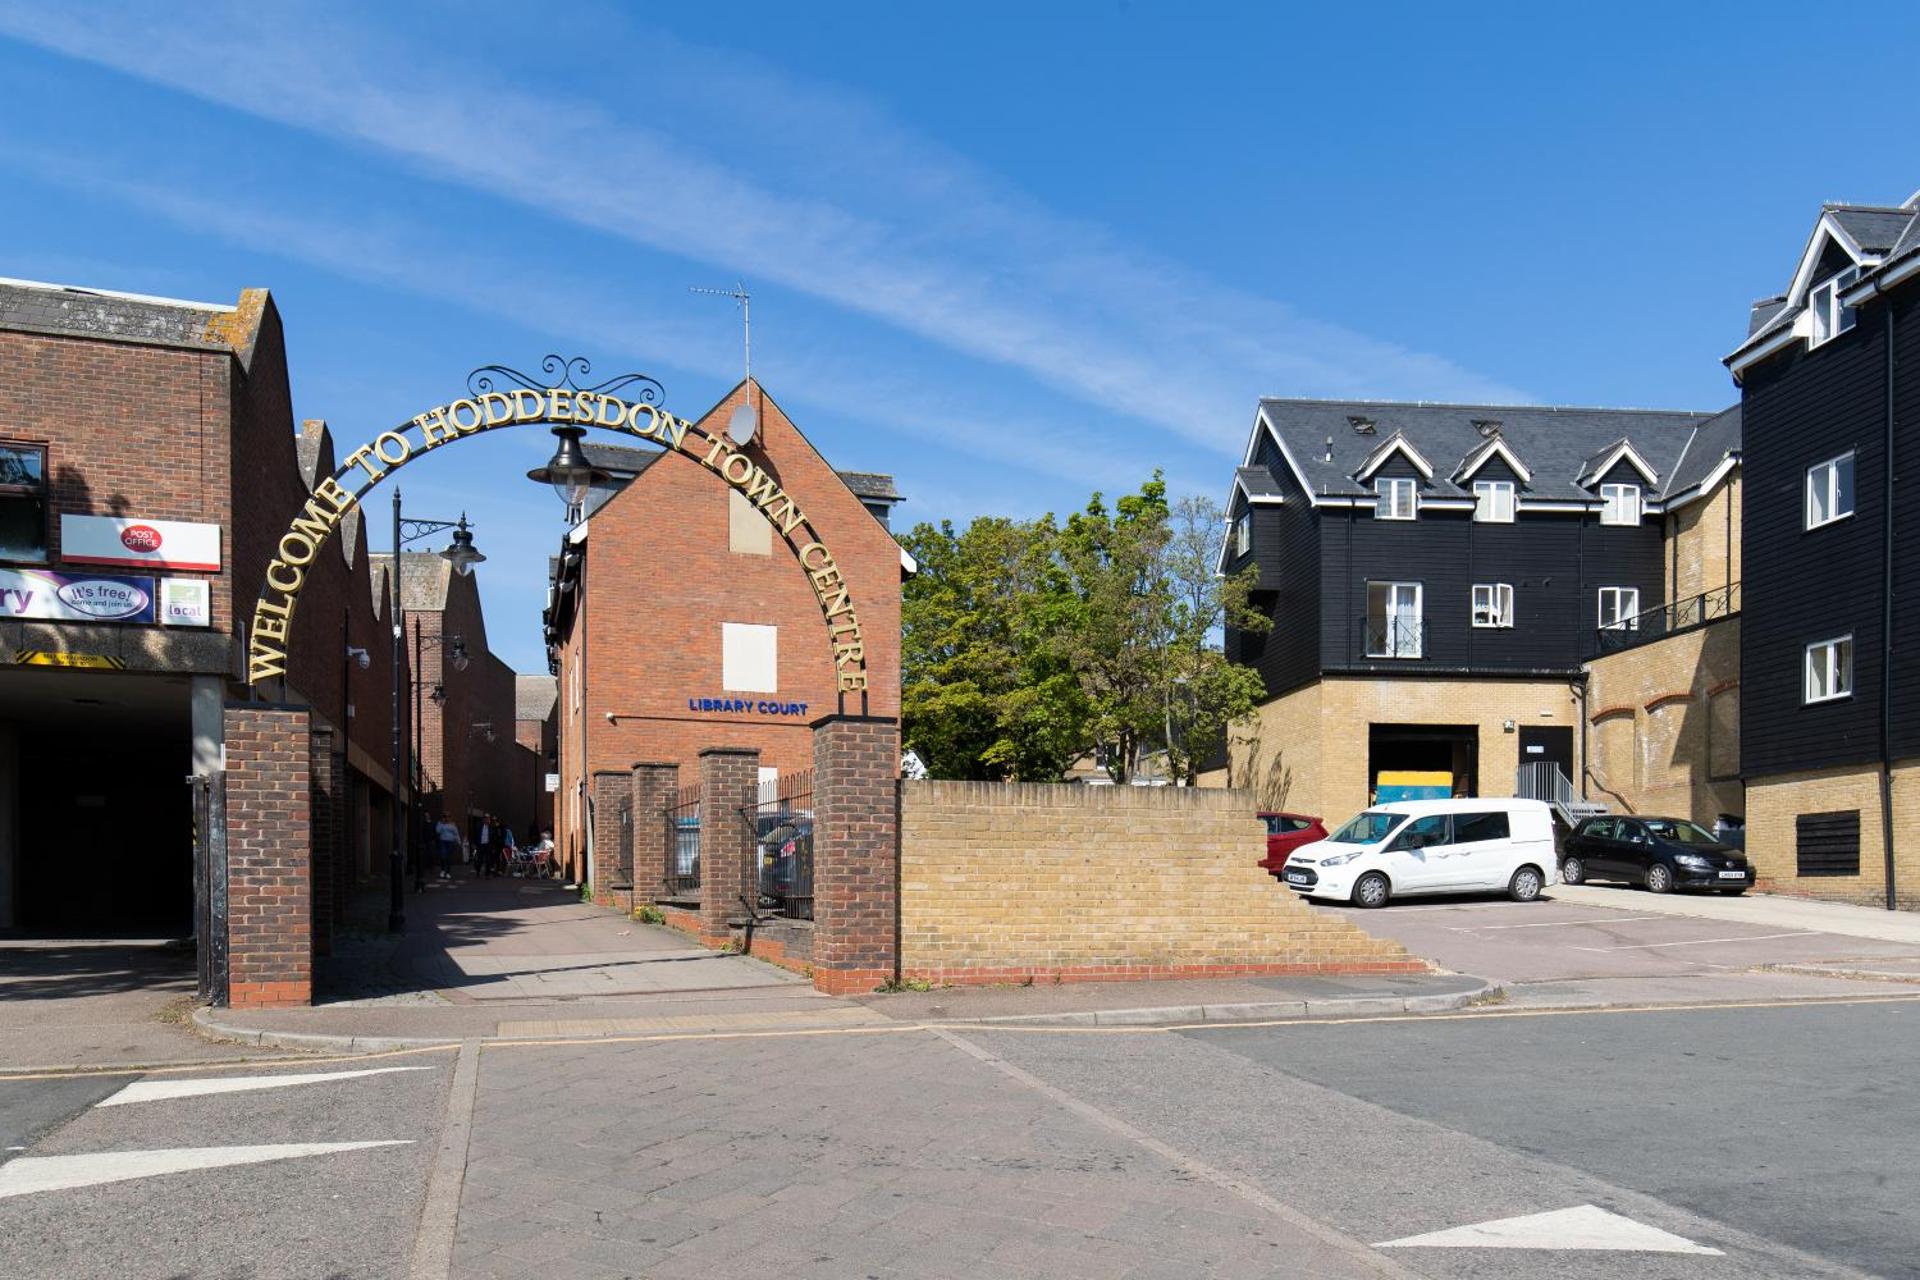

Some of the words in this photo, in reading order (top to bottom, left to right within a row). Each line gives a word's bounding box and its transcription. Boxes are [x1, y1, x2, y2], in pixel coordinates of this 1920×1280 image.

[130, 530, 154, 539] POST
[249, 477, 356, 685] WELCOME
[344, 431, 411, 483] TO
[414, 388, 692, 450] HODDESDON
[701, 432, 808, 537] TOWN
[800, 543, 868, 692] CENTRE
[124, 537, 158, 548] OFFICE
[71, 586, 94, 600] It's
[98, 585, 132, 601] free!
[169, 605, 202, 617] local
[688, 698, 753, 713] LIBRARY
[757, 701, 808, 716] COURT
